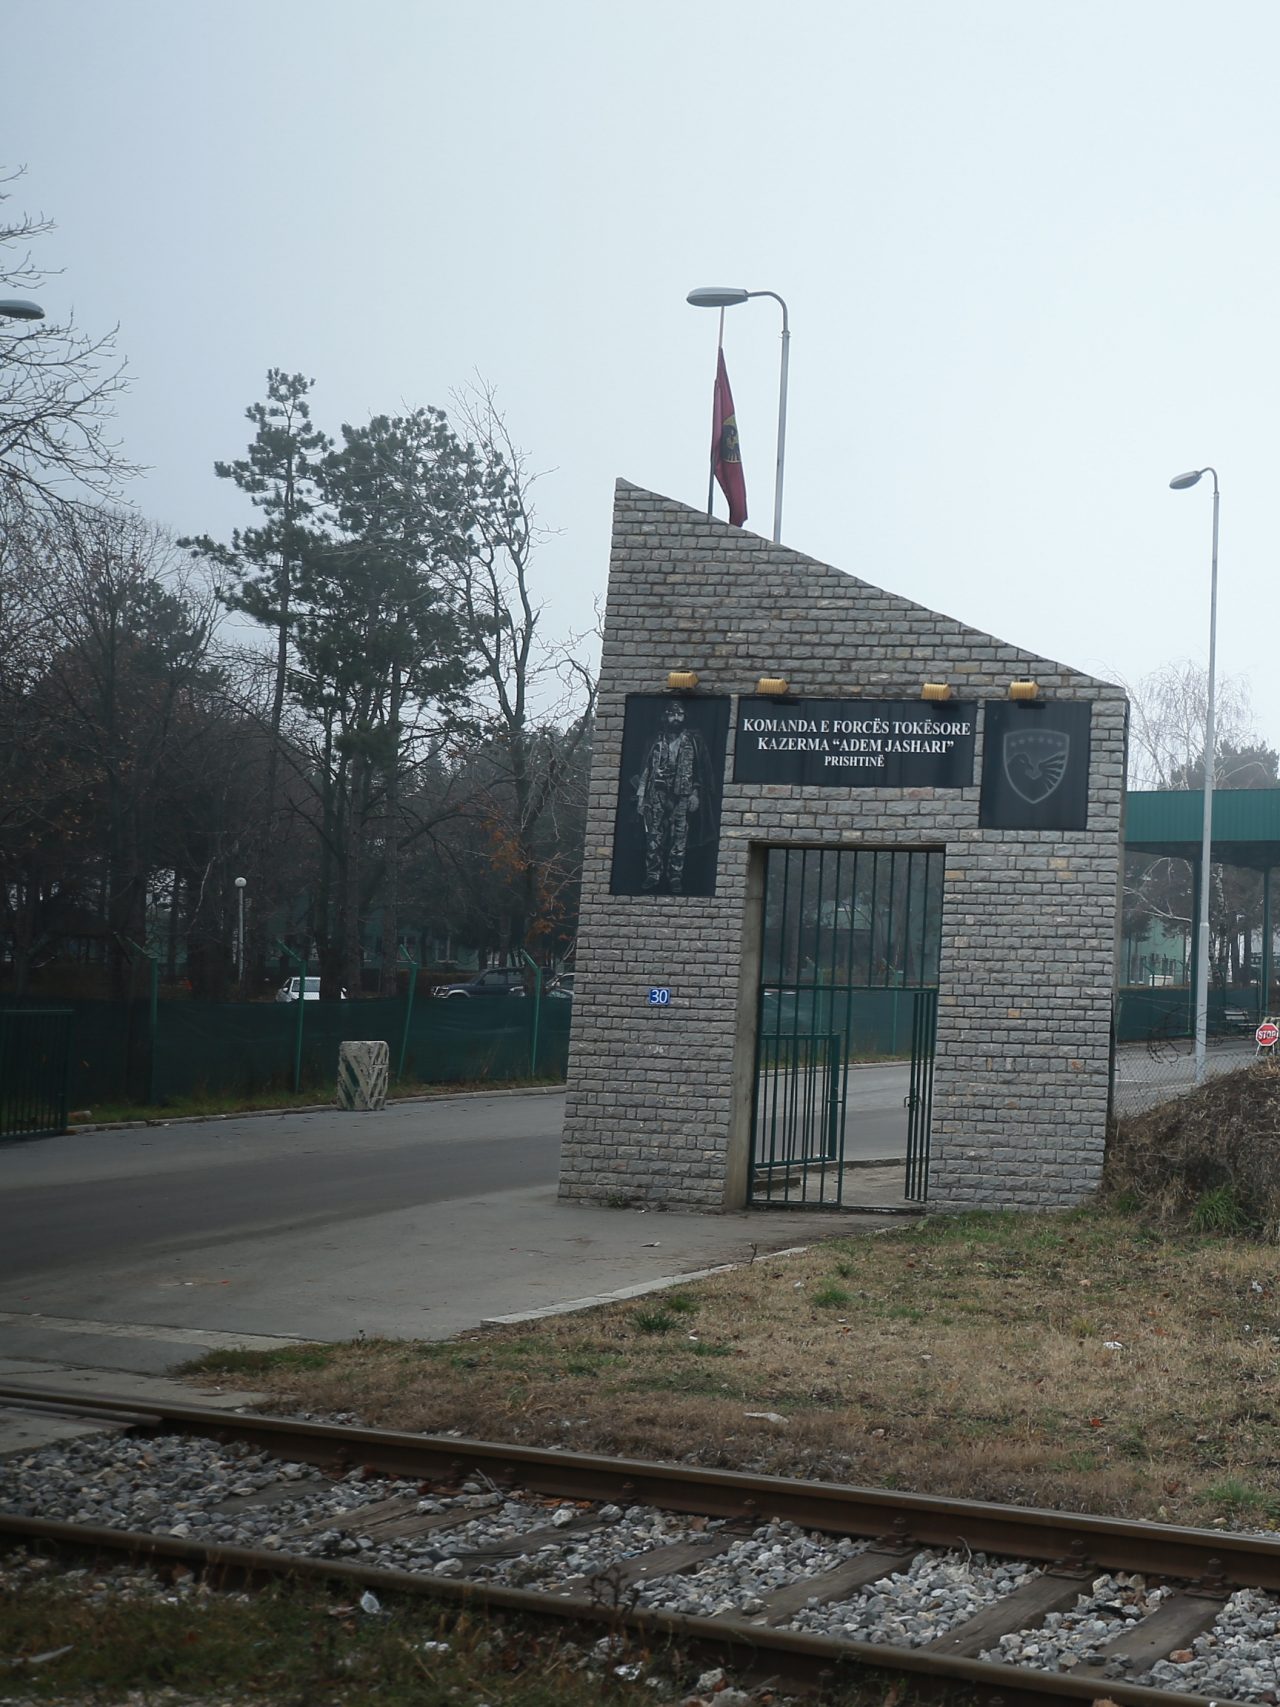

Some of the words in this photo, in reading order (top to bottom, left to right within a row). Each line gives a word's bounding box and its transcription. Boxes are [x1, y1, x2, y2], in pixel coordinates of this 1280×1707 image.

[743, 719, 817, 732] KOMANDA
[821, 720, 830, 732] E
[834, 718, 889, 733] FORCËS
[893, 719, 971, 735] TOKËSORE
[757, 737, 830, 751] KAZERMA
[832, 738, 882, 752] “ADEM
[885, 740, 954, 753] JASHARI”
[824, 755, 885, 767] PRISHTINË
[650, 989, 667, 1003] 30
[1258, 1030, 1276, 1039] STOP
